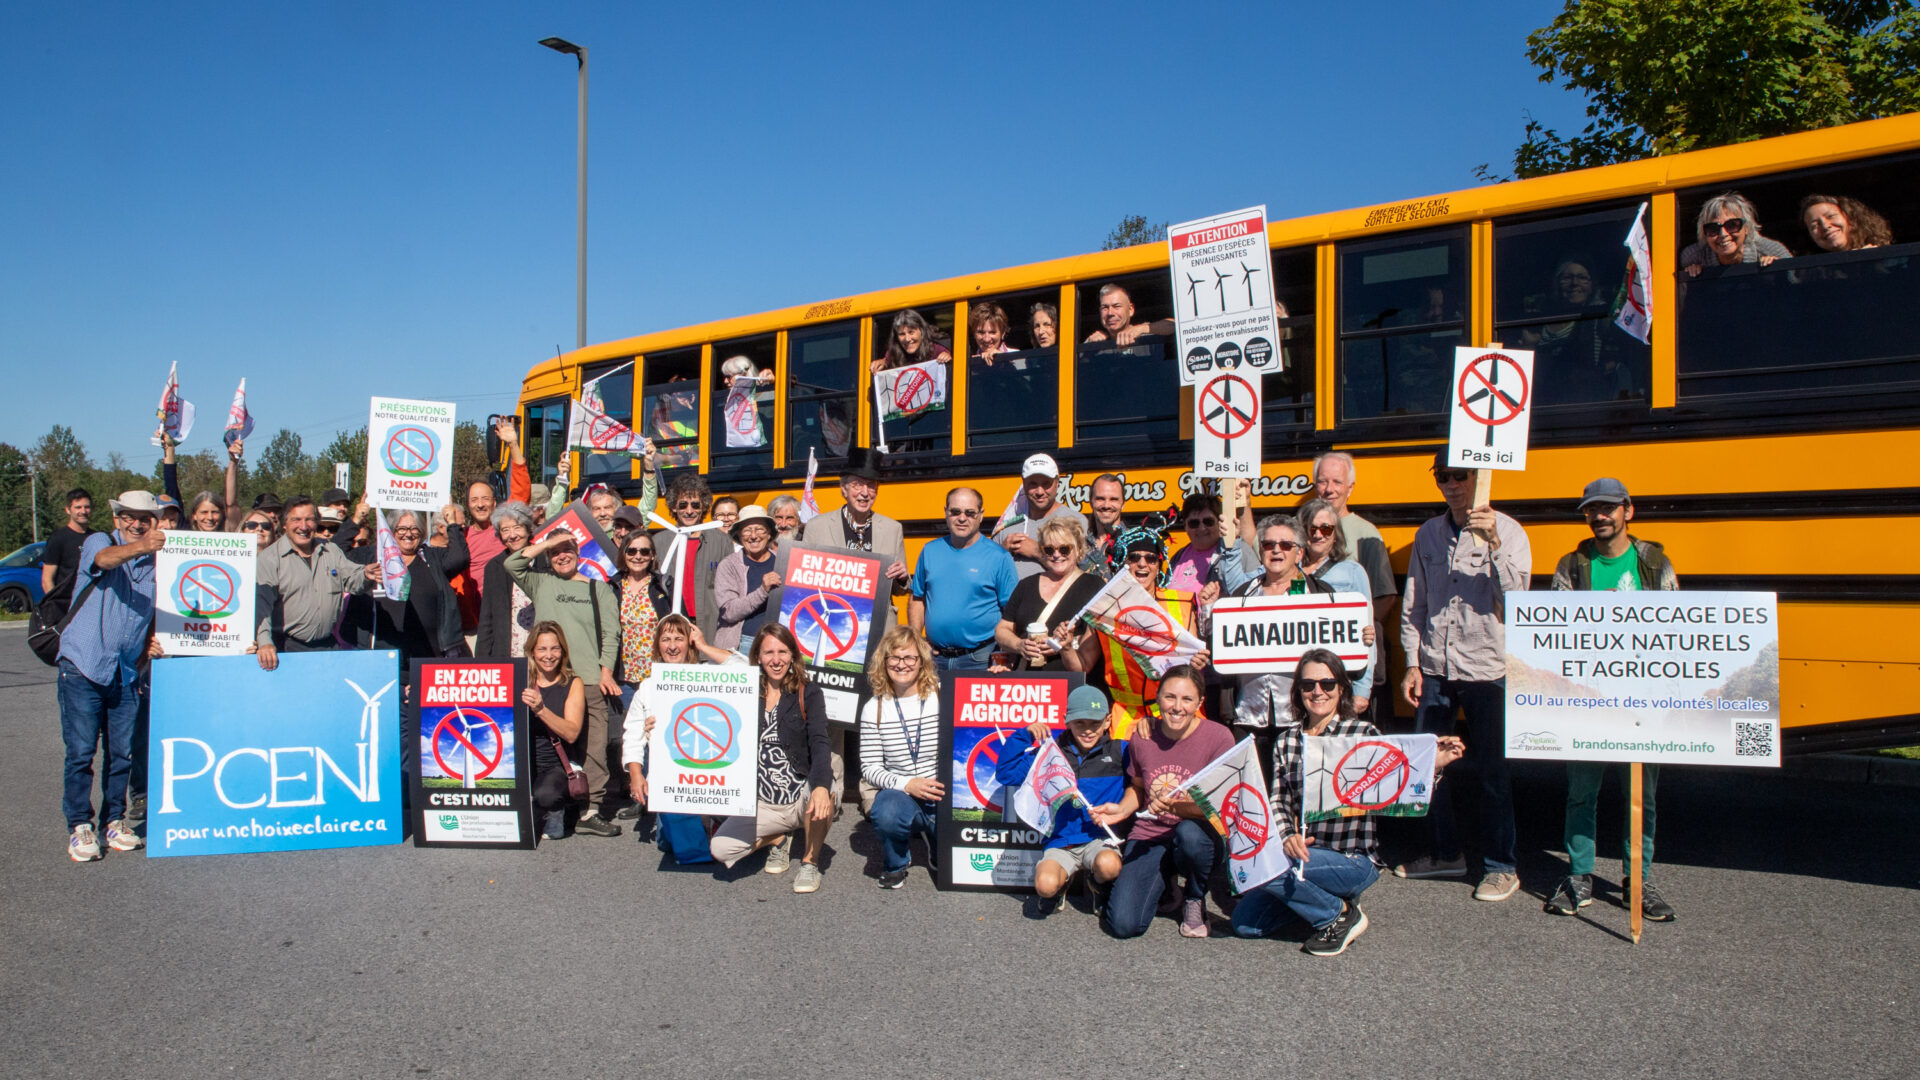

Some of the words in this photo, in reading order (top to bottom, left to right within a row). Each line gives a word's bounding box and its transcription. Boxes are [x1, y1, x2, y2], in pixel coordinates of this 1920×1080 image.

[1364, 214, 1394, 228] SORTIE
[1396, 211, 1408, 222] DE
[1409, 204, 1450, 221] SECOURS
[1369, 201, 1426, 218] EMERGENCY
[1427, 197, 1449, 208] EXIT
[1187, 221, 1248, 247] ATTENTION
[1181, 246, 1216, 259] PRÉSENCE
[1217, 237, 1256, 252] D'ESPÈCES
[1191, 249, 1248, 267] ENVAHISSANTES
[1182, 322, 1231, 336] mobilisez-vous
[1231, 318, 1247, 328] pour
[1258, 315, 1270, 324] pas
[1185, 334, 1213, 345] propager
[1214, 331, 1225, 339] les
[1226, 324, 1269, 337] envahisseurs
[375, 412, 400, 420] NOTRE
[399, 413, 428, 422] QUALITÉ
[380, 402, 447, 416] PRÉSERVONS
[1462, 449, 1491, 462] Pas
[1496, 451, 1513, 463] ici
[1205, 461, 1230, 472] Pas
[1234, 462, 1249, 472] ici
[388, 489, 412, 497] MILIEU
[413, 490, 438, 498] HABITÉ
[390, 480, 427, 490] NON
[1055, 473, 1166, 512] Aubus
[395, 496, 430, 504] AGRICOLE
[168, 536, 247, 549] PRÉSERVONS
[162, 547, 190, 555] NOTRE
[191, 548, 225, 557] QUALITÉ
[802, 554, 823, 571] EN
[824, 557, 867, 578] ZONE
[791, 568, 872, 595] AGRICOLE
[1516, 606, 1567, 623] NON
[1573, 606, 1605, 623] AU
[1611, 606, 1717, 624] SACCAGE
[1724, 607, 1768, 624] DES
[184, 622, 227, 633] NON
[1222, 617, 1359, 648] LANAUDIÈRE
[182, 633, 210, 641] MILIEU
[212, 633, 240, 641] HABITÉ
[1533, 633, 1625, 650] MILIEUX
[1632, 633, 1751, 652] NATURELS
[435, 669, 457, 685] EN
[459, 669, 501, 685] ZONE
[662, 669, 748, 684] PRÉSERVONS
[1562, 660, 1588, 677] ET
[1592, 661, 1721, 679] AGRICOLES
[817, 672, 855, 689] NON!
[426, 686, 508, 703] AGRICOLE
[656, 684, 685, 692] NOTRE
[687, 684, 723, 694] QUALITÉ
[726, 686, 737, 694] DE
[739, 686, 753, 695] VIE
[970, 684, 995, 702] EN
[1000, 684, 1052, 703] ZONE
[1514, 694, 1543, 707] OUI
[1547, 697, 1563, 707] au
[1567, 696, 1619, 711] respect
[1623, 695, 1648, 709] des
[1651, 696, 1714, 710] volontés
[1717, 697, 1769, 712] locales
[960, 703, 1060, 724] AGRICOLE
[1573, 738, 1715, 755] brandonsanshydro.info
[679, 773, 725, 786] NON
[1347, 752, 1398, 801] MORATOIRE
[430, 793, 470, 806] C'EST
[471, 794, 510, 806] NON!
[664, 786, 675, 794] EN
[677, 787, 706, 795] MILIEU
[708, 787, 741, 797] HABITÉ
[674, 795, 684, 803] ET
[685, 796, 729, 805] AGRICOLE
[1229, 805, 1264, 838] MTOIRE
[960, 828, 1009, 843] C'EST
[1012, 829, 1044, 844] NO
[970, 853, 994, 862] UPA
